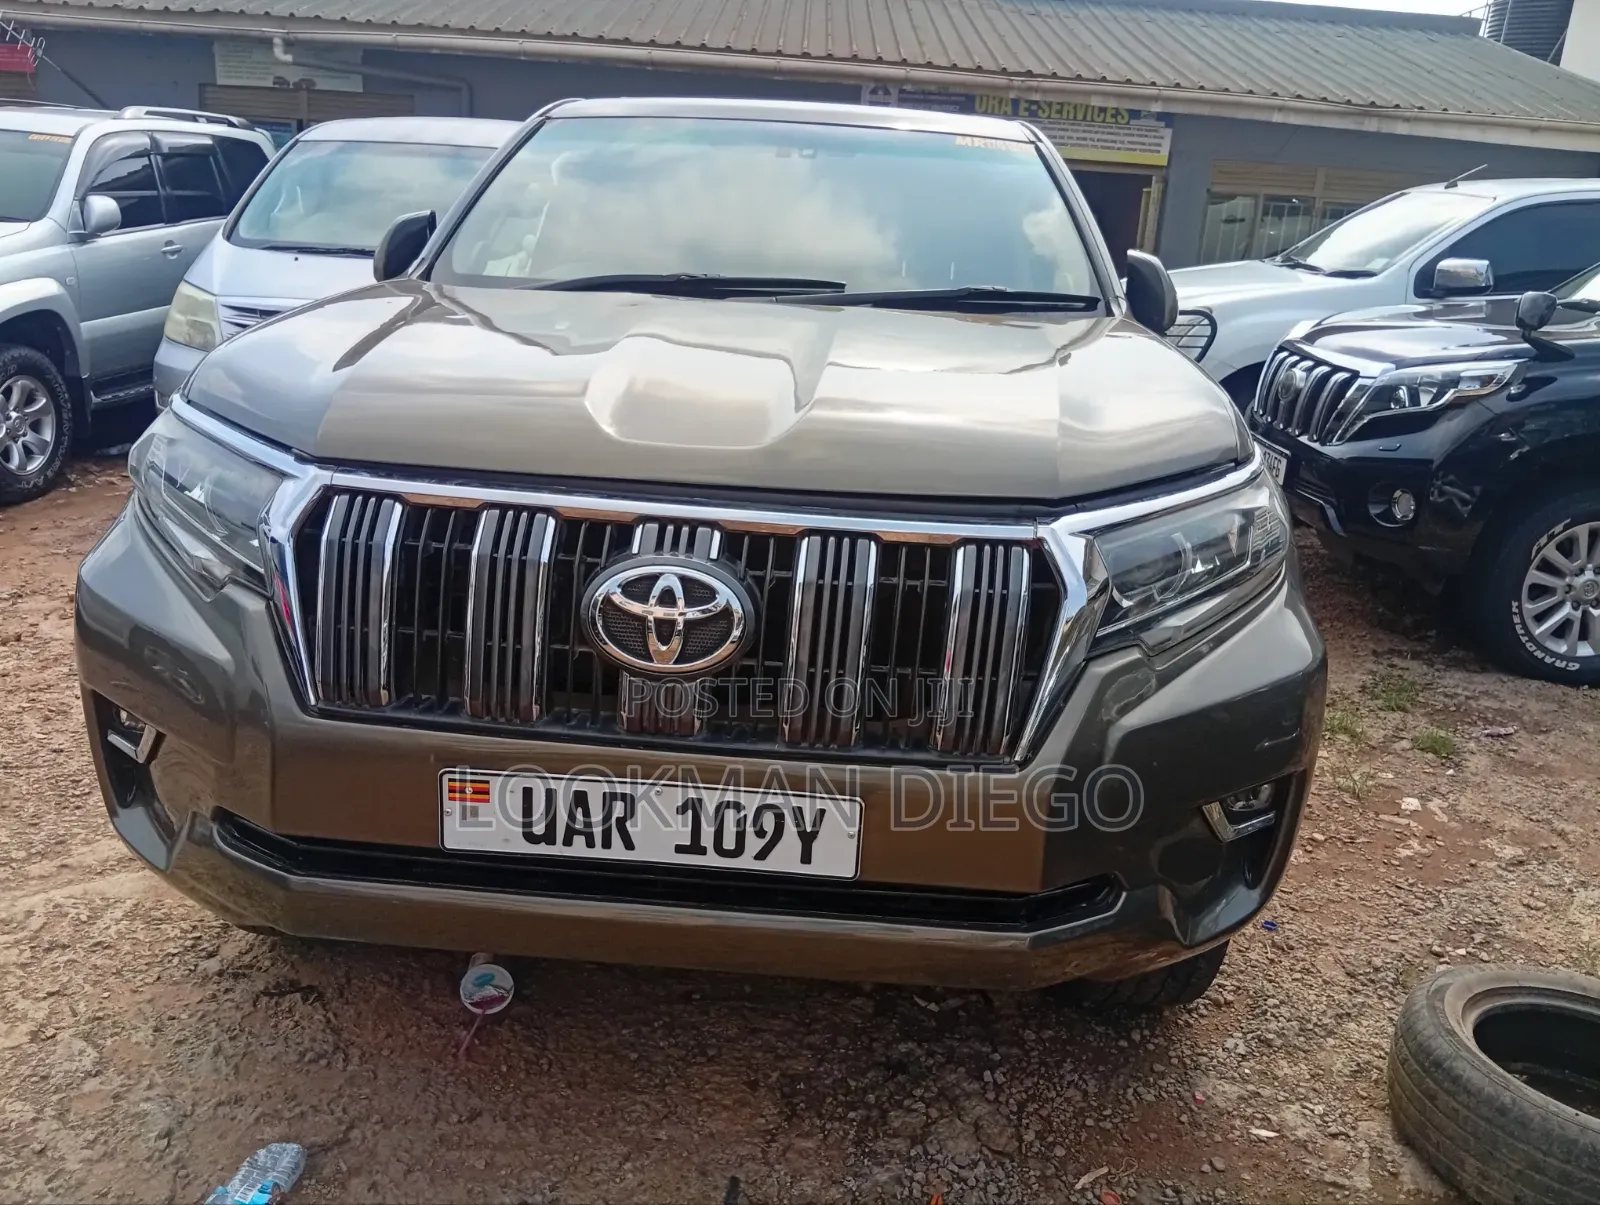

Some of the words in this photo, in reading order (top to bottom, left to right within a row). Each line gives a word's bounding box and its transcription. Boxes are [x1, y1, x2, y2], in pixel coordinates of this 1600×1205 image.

[1017, 99, 1129, 125] E-SERVICES
[1511, 600, 1581, 671] GRANDTREK
[521, 786, 636, 851] UAR
[674, 796, 827, 865] 109Y
